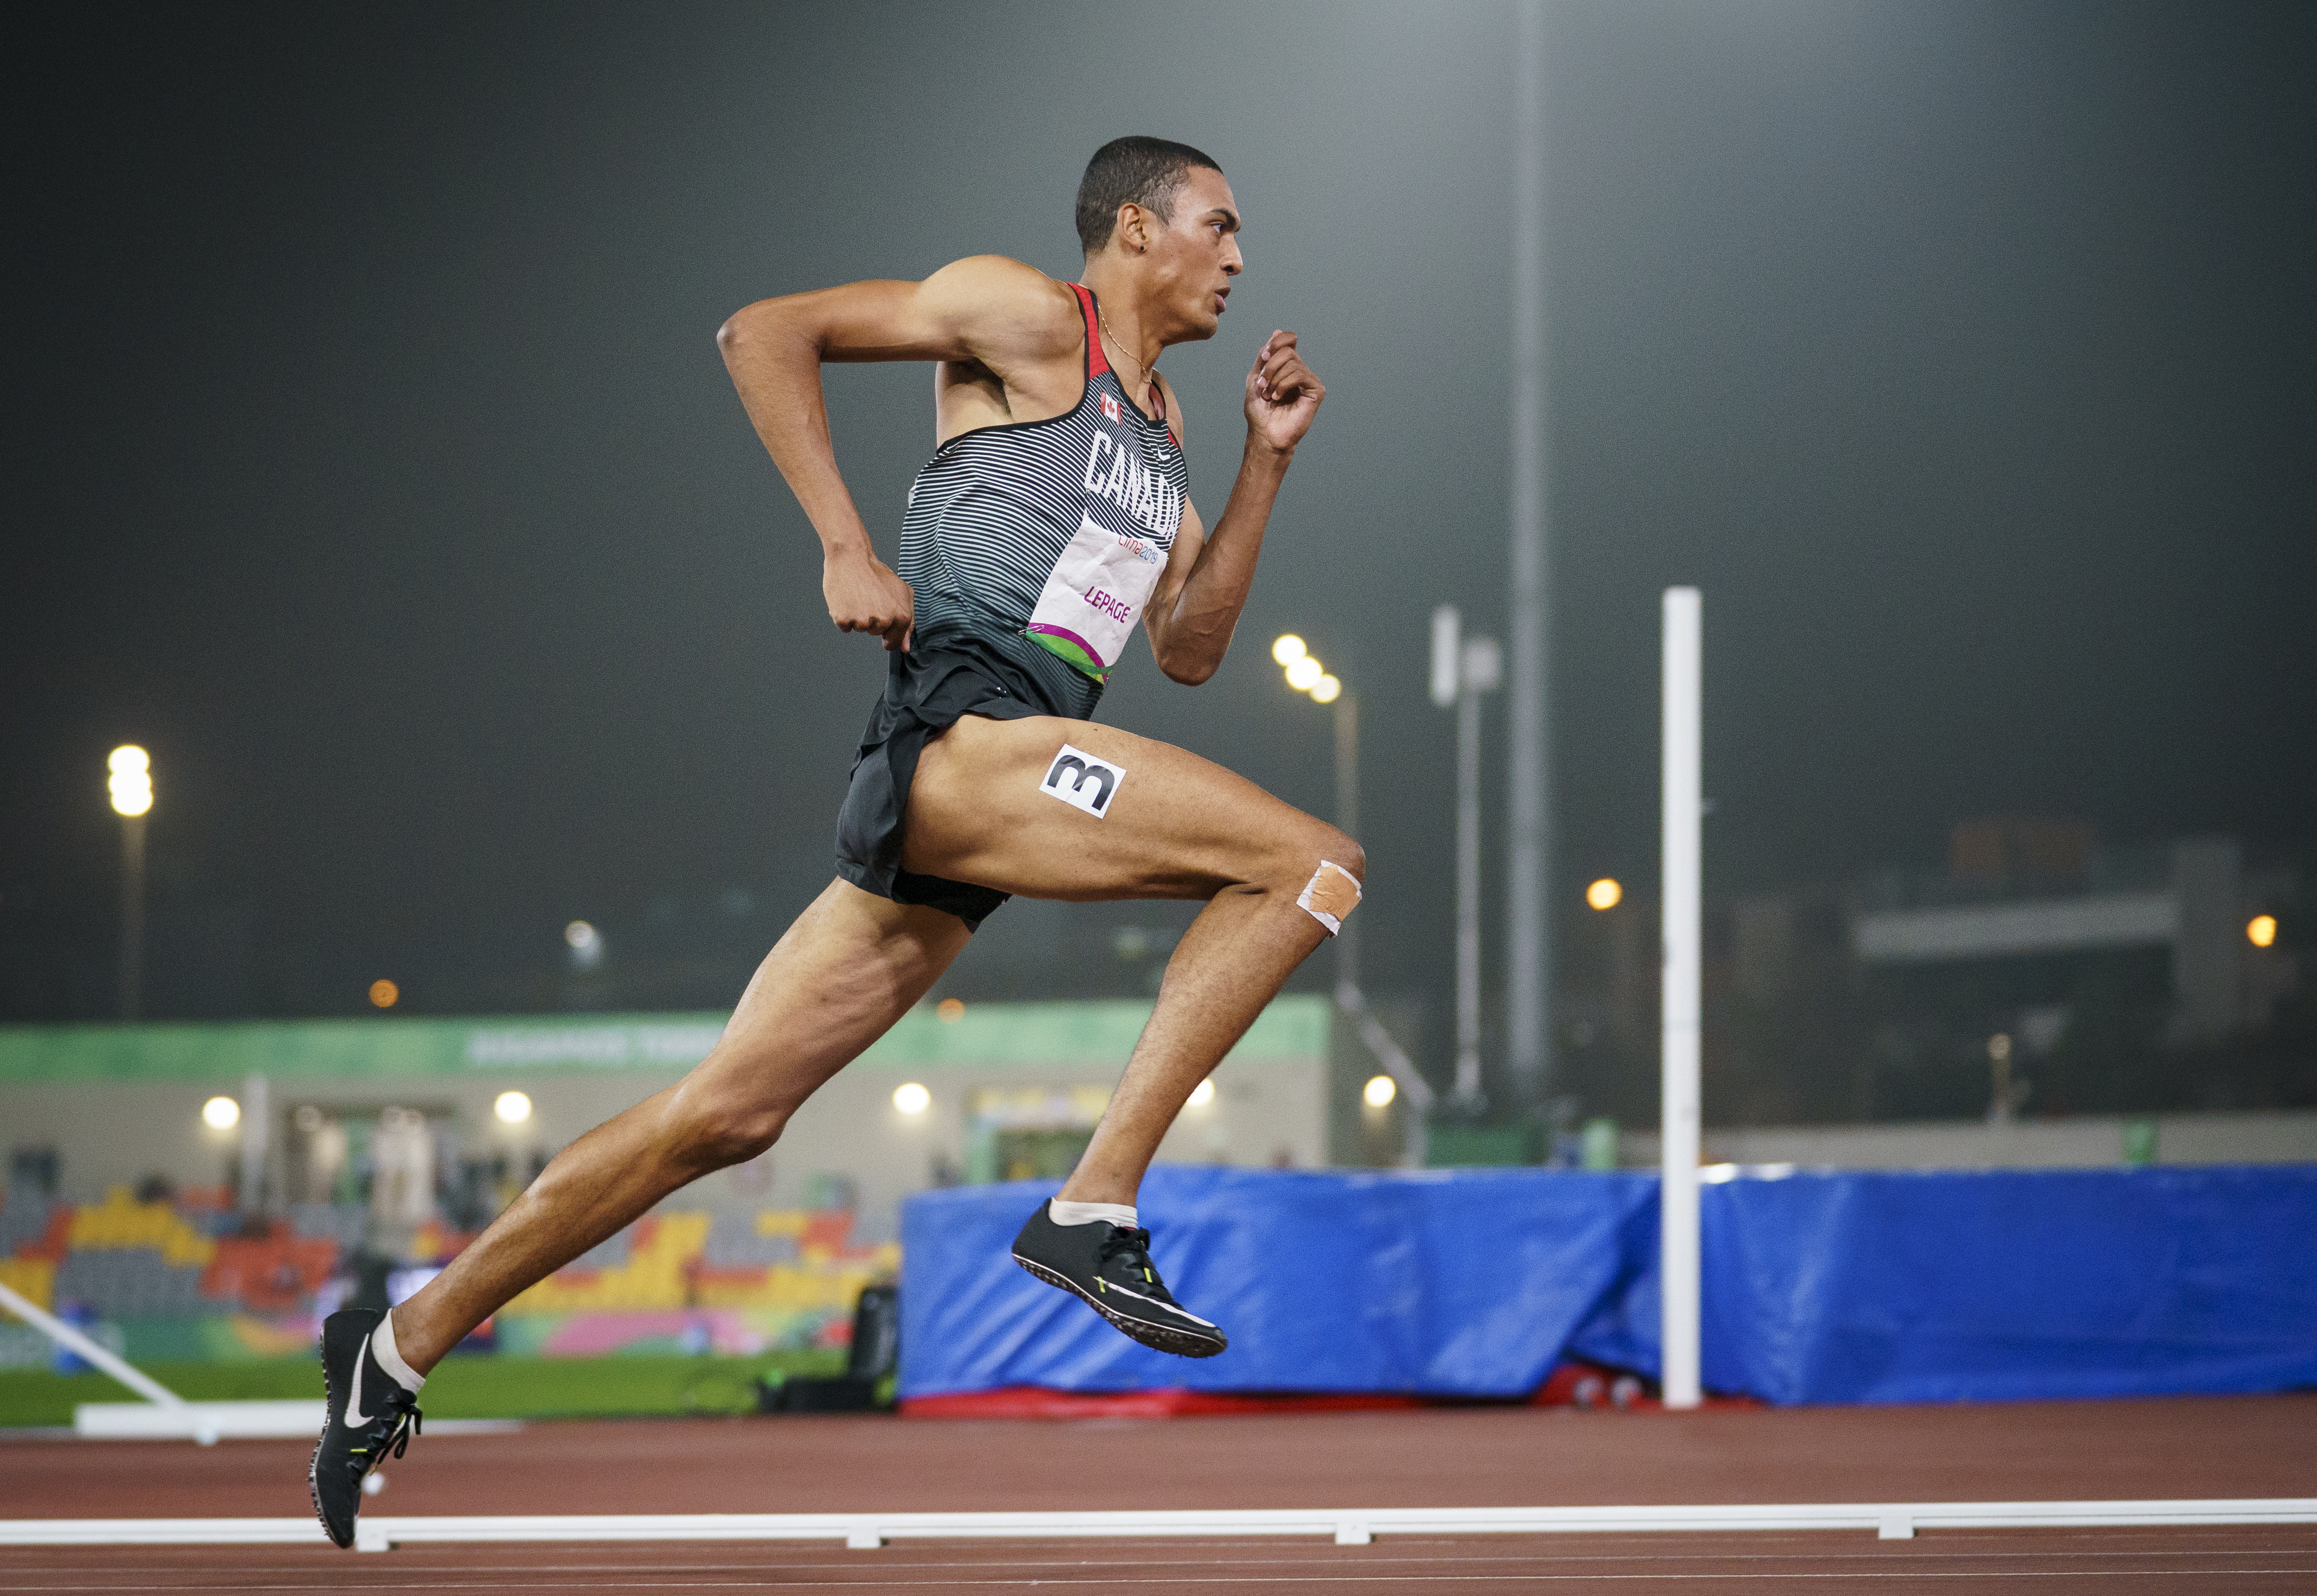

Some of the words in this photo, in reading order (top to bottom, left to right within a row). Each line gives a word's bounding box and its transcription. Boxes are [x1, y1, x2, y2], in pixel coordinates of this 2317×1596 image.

[1085, 429, 1179, 548] CANADA
[1084, 586, 1131, 624] LEPAGE
[1047, 755, 1115, 811] 3
